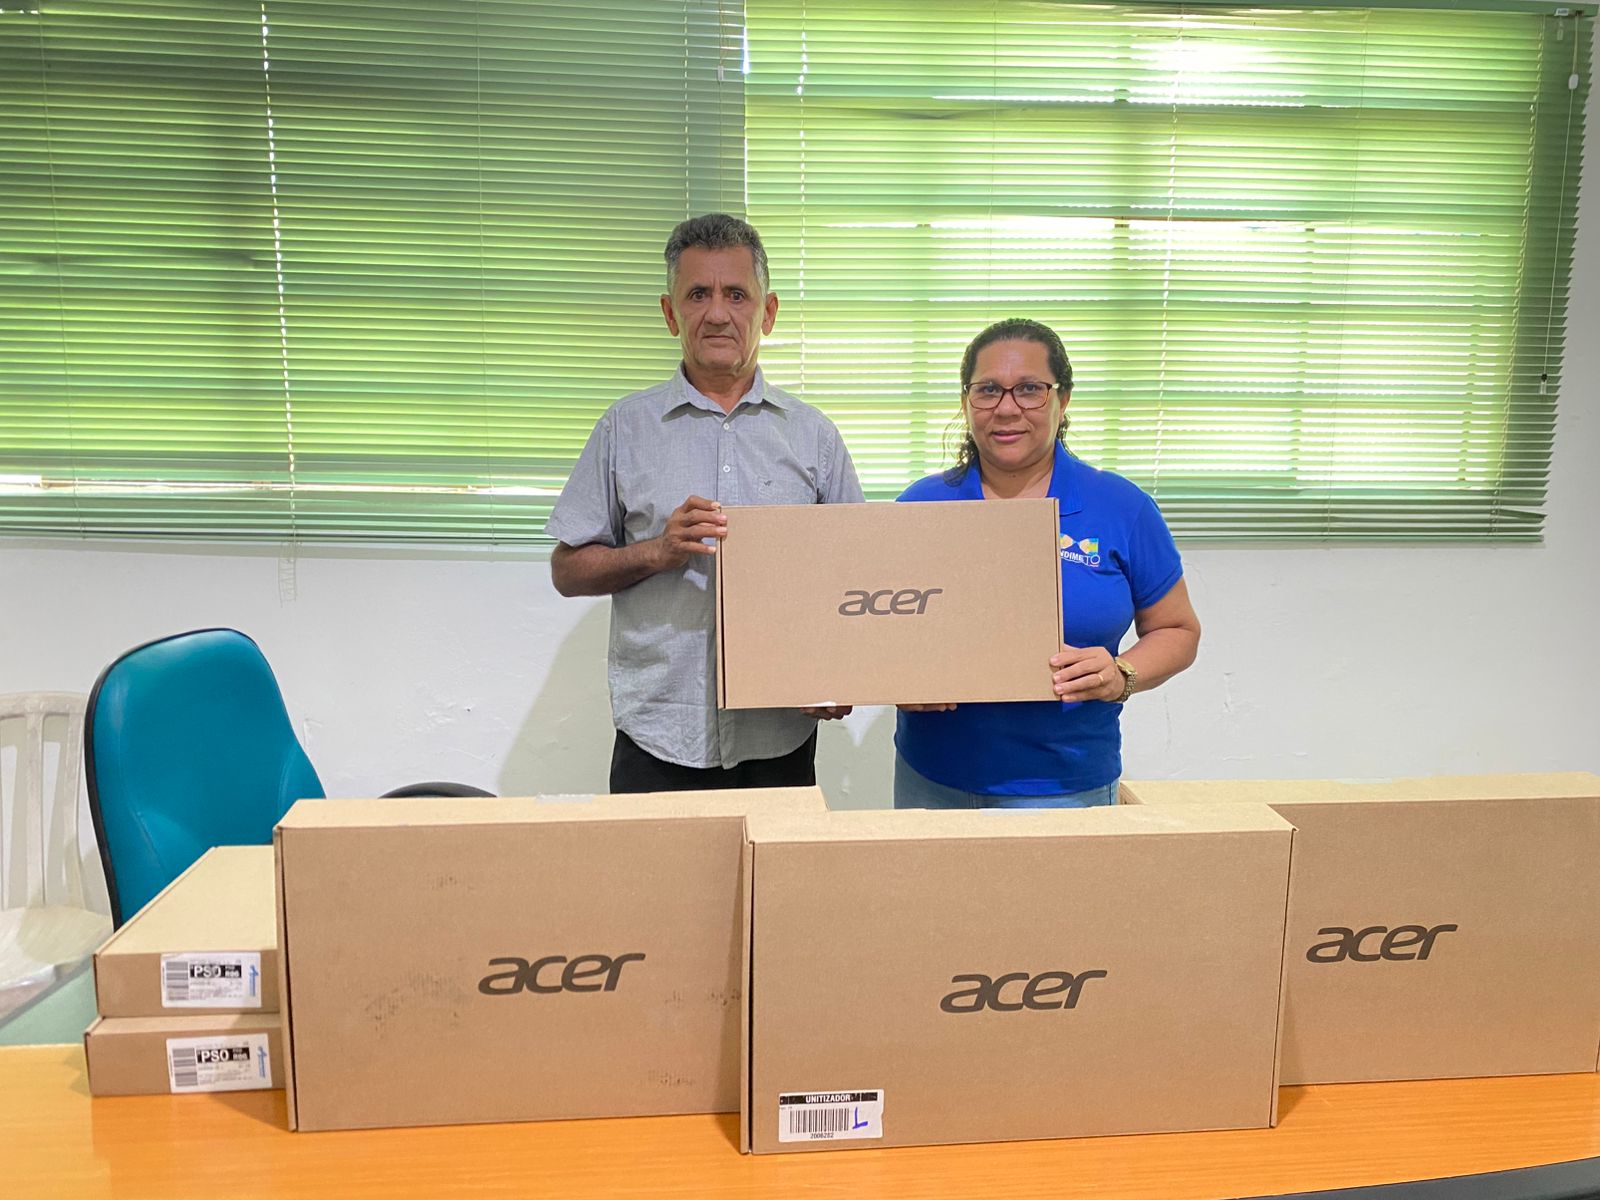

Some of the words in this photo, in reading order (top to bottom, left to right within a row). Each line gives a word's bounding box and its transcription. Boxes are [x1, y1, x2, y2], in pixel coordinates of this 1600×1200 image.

[838, 588, 943, 616] acer
[1307, 924, 1458, 964] acer
[478, 952, 646, 996] acer
[940, 969, 1108, 1014] acer
[805, 1094, 851, 1104] UNITIZADOR
